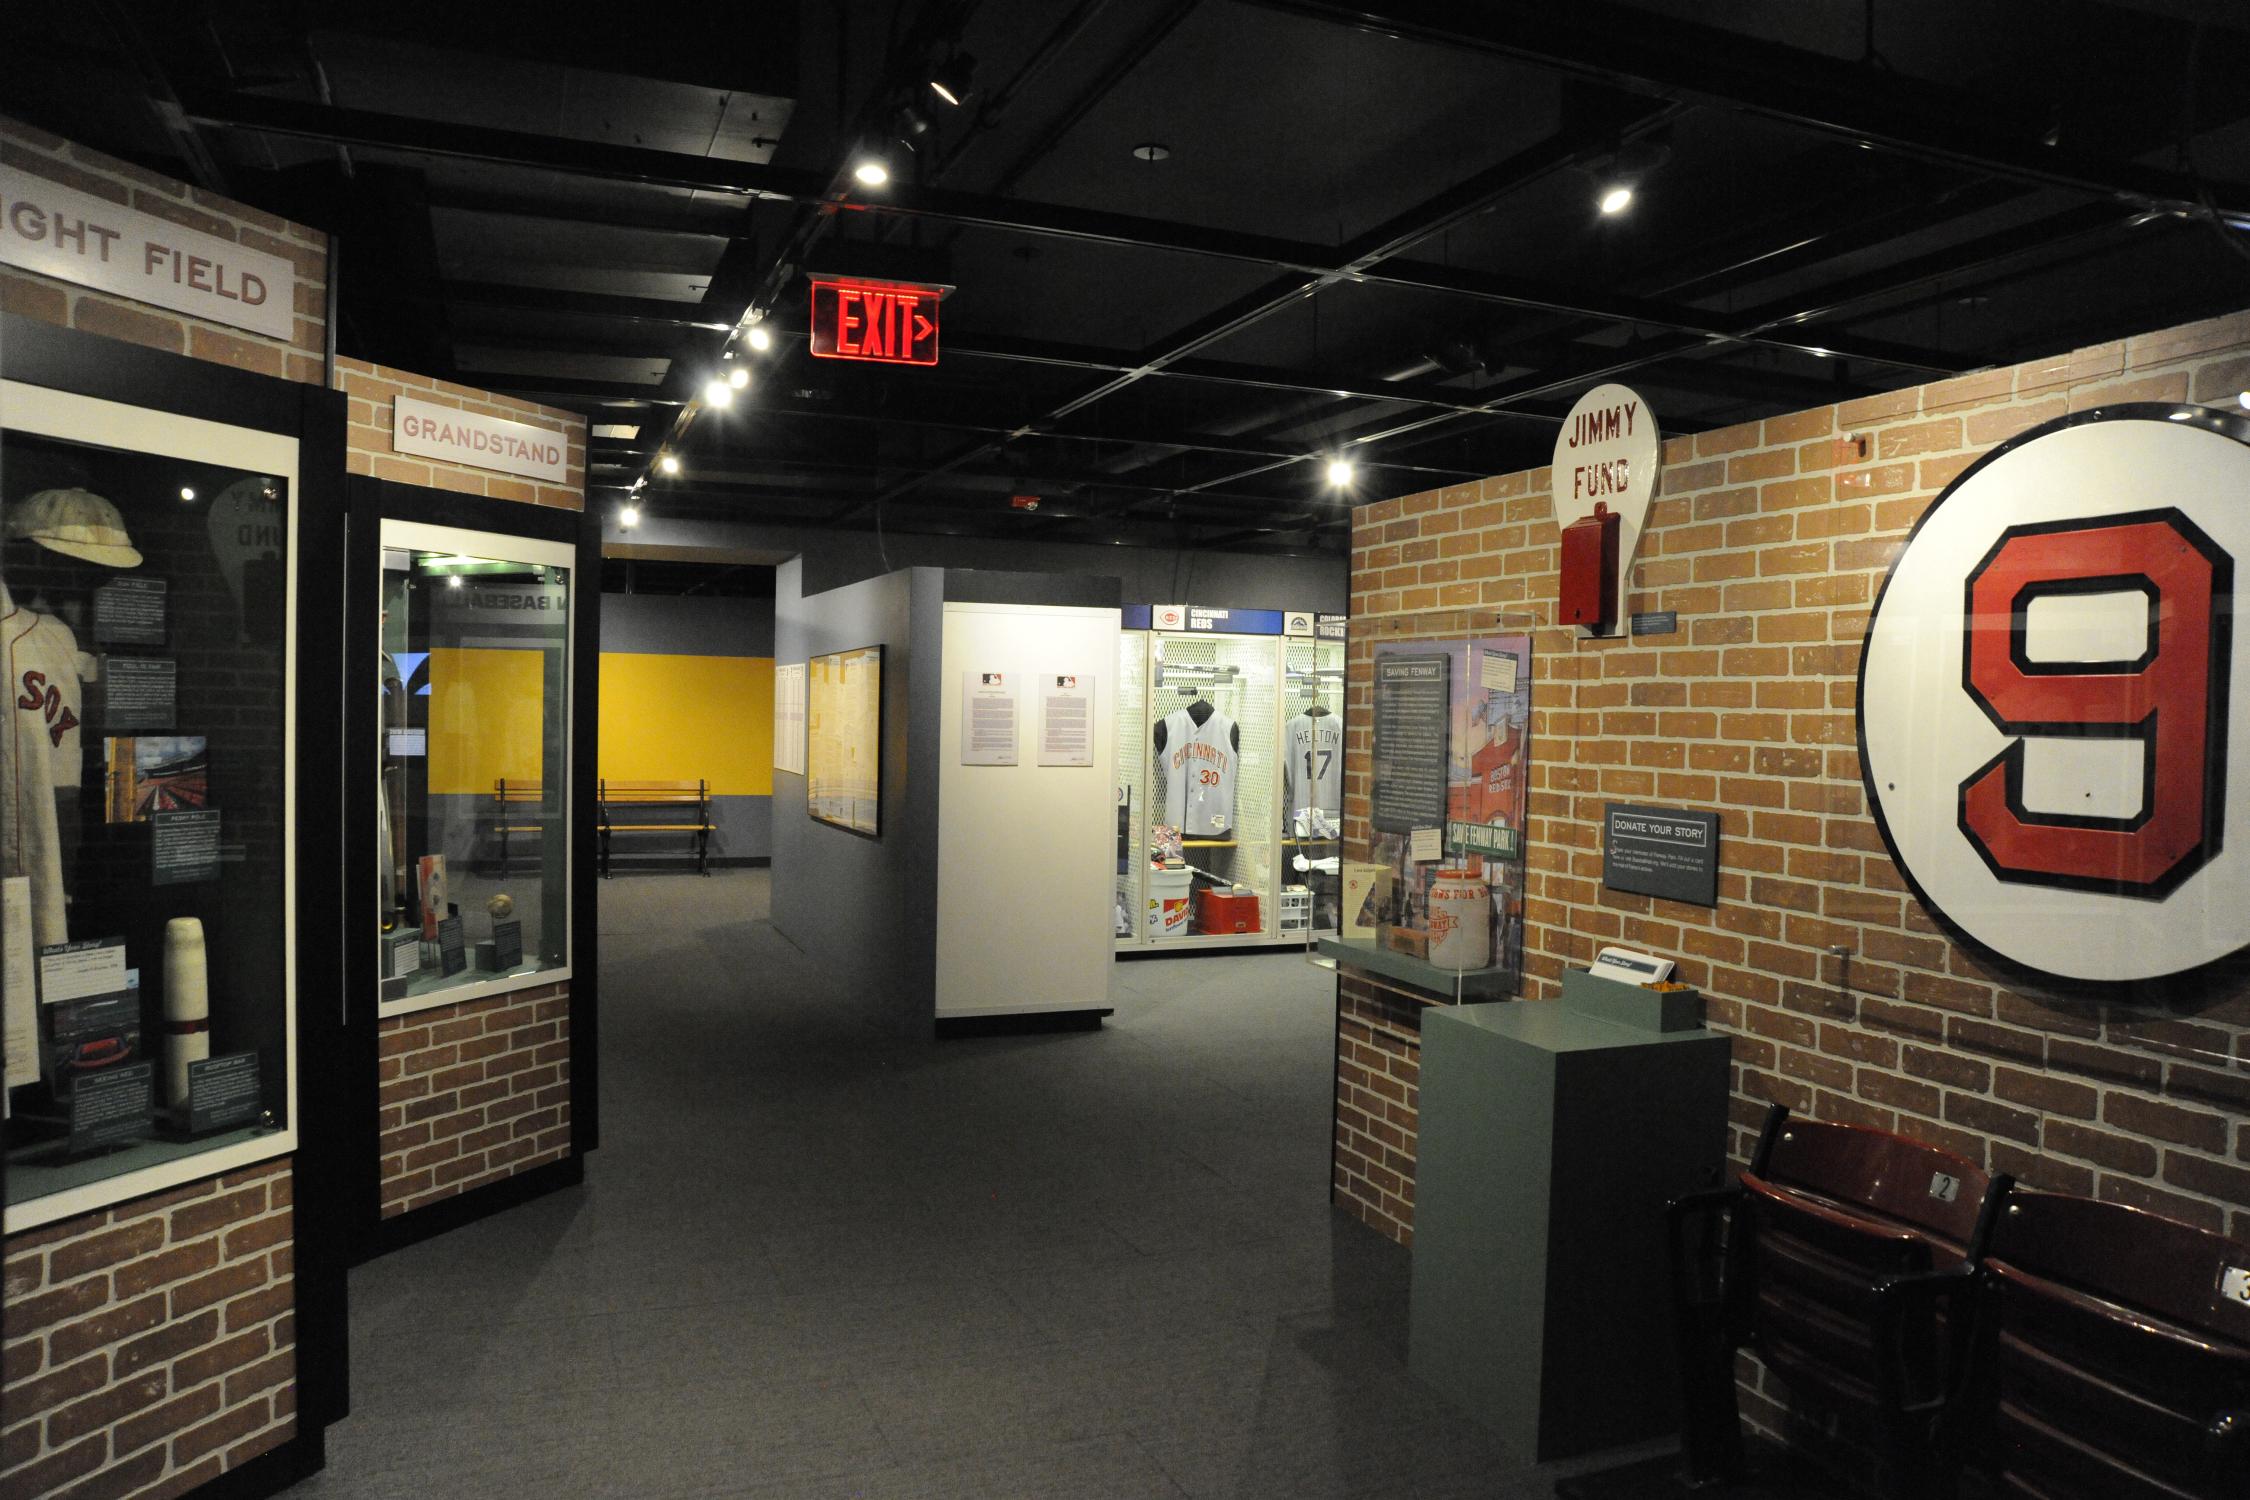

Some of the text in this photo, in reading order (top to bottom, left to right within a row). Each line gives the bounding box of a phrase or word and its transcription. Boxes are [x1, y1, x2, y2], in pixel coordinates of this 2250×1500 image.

[0, 194, 268, 306] GHT FIELD
[836, 289, 919, 359] EXIT
[1568, 400, 1638, 449] JIMMY
[402, 415, 561, 467] GRANDSTAND
[1574, 458, 1630, 500] FUND
[1190, 608, 1229, 619] CINCINNATI
[1190, 618, 1213, 630] REDS
[1386, 666, 1436, 677] SAVING FENWAY
[1957, 506, 2234, 902] 9
[1173, 743, 1229, 771] CINCINNATI
[1304, 750, 1332, 780] 17
[1200, 770, 1219, 786] 30
[1453, 823, 1469, 844] SAVE
[1470, 826, 1492, 848] FENWAY
[1614, 820, 1704, 839] DONATE YOUR STORY
[1938, 1176, 1951, 1199] 2
